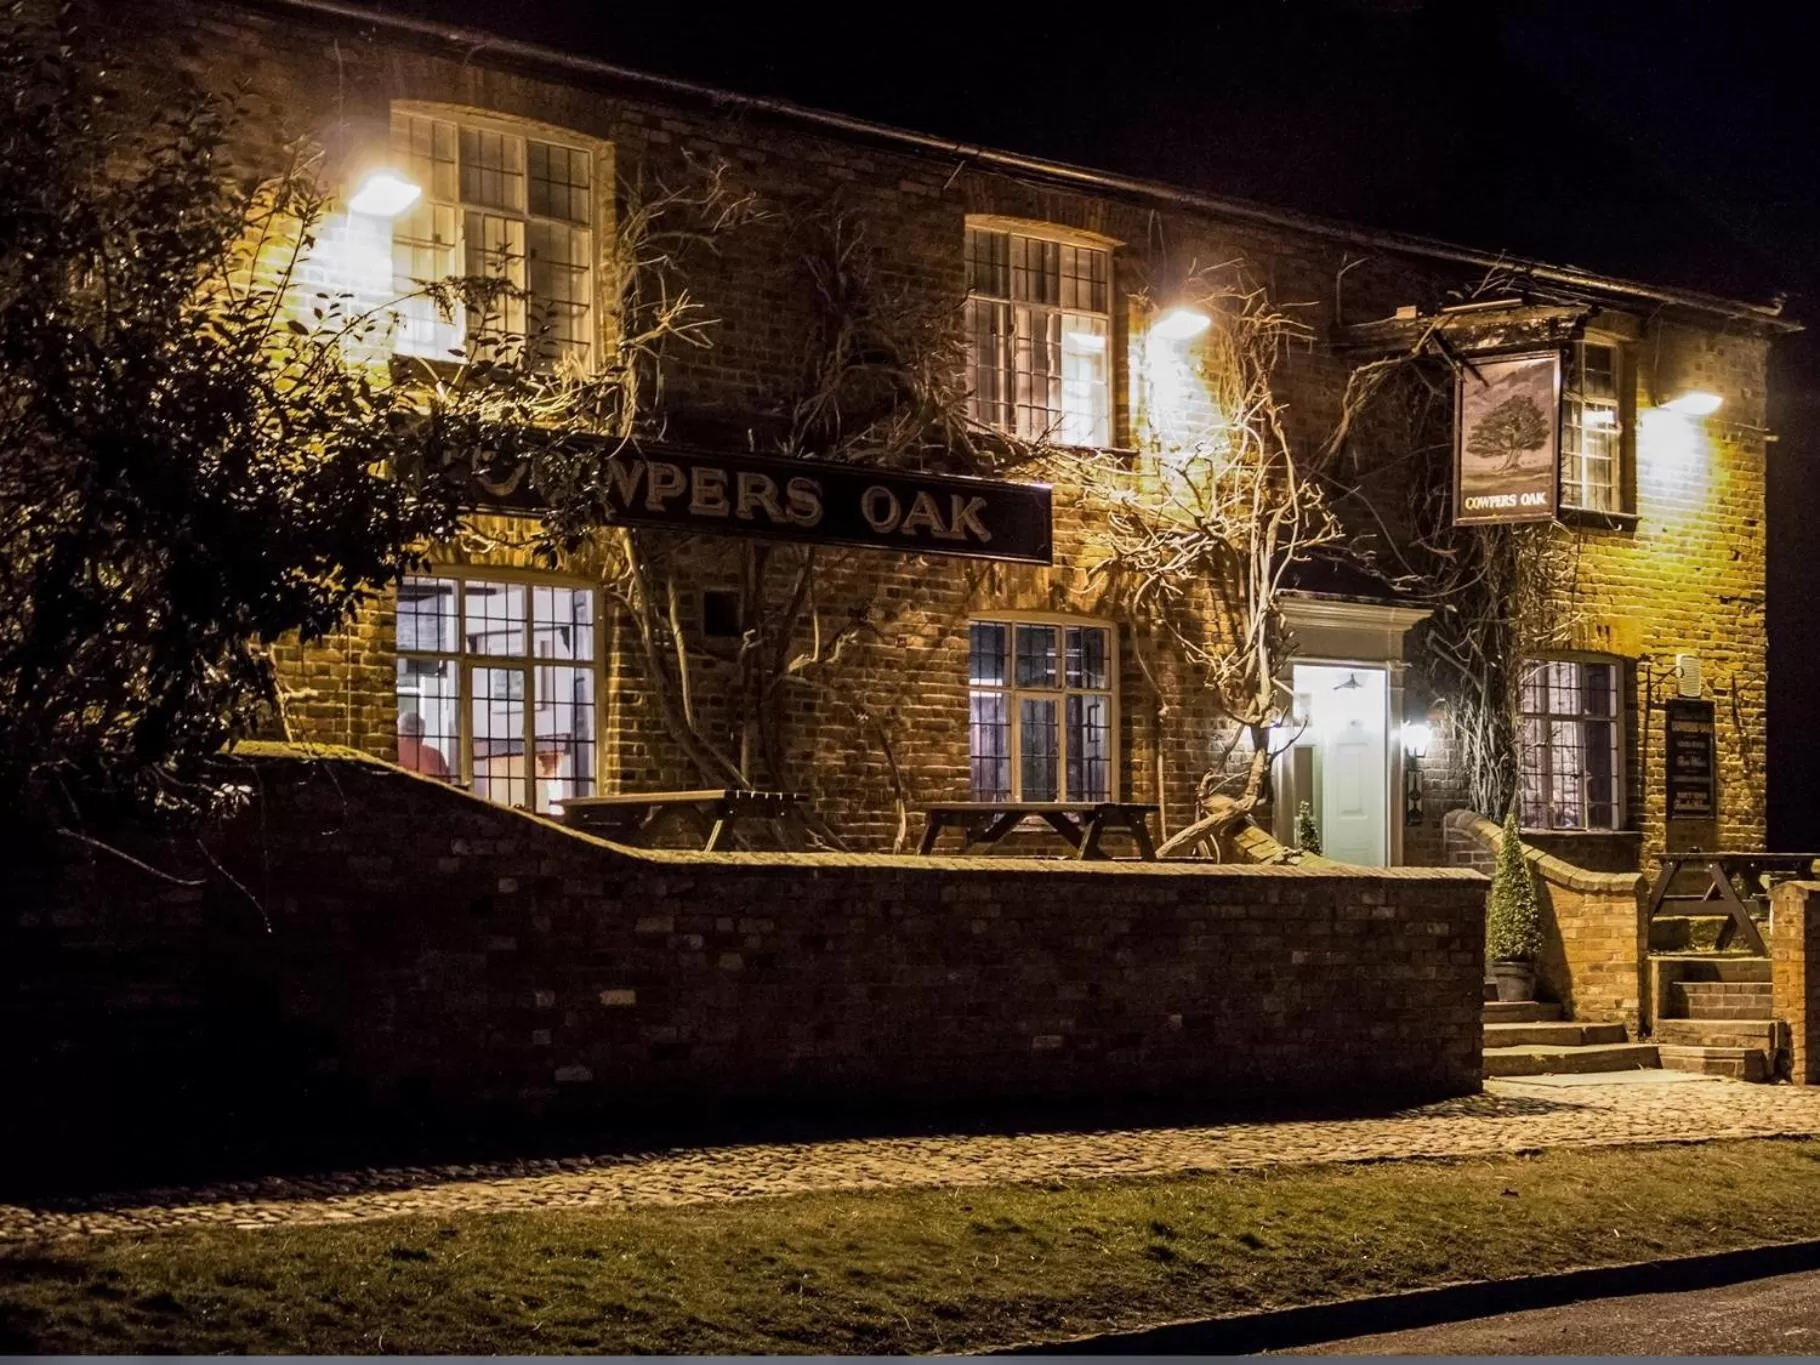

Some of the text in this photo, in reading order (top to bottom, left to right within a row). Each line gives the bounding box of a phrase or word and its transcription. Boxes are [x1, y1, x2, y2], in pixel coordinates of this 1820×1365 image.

[861, 485, 993, 543] OAK
[1465, 491, 1547, 510] COWPERS OAK
